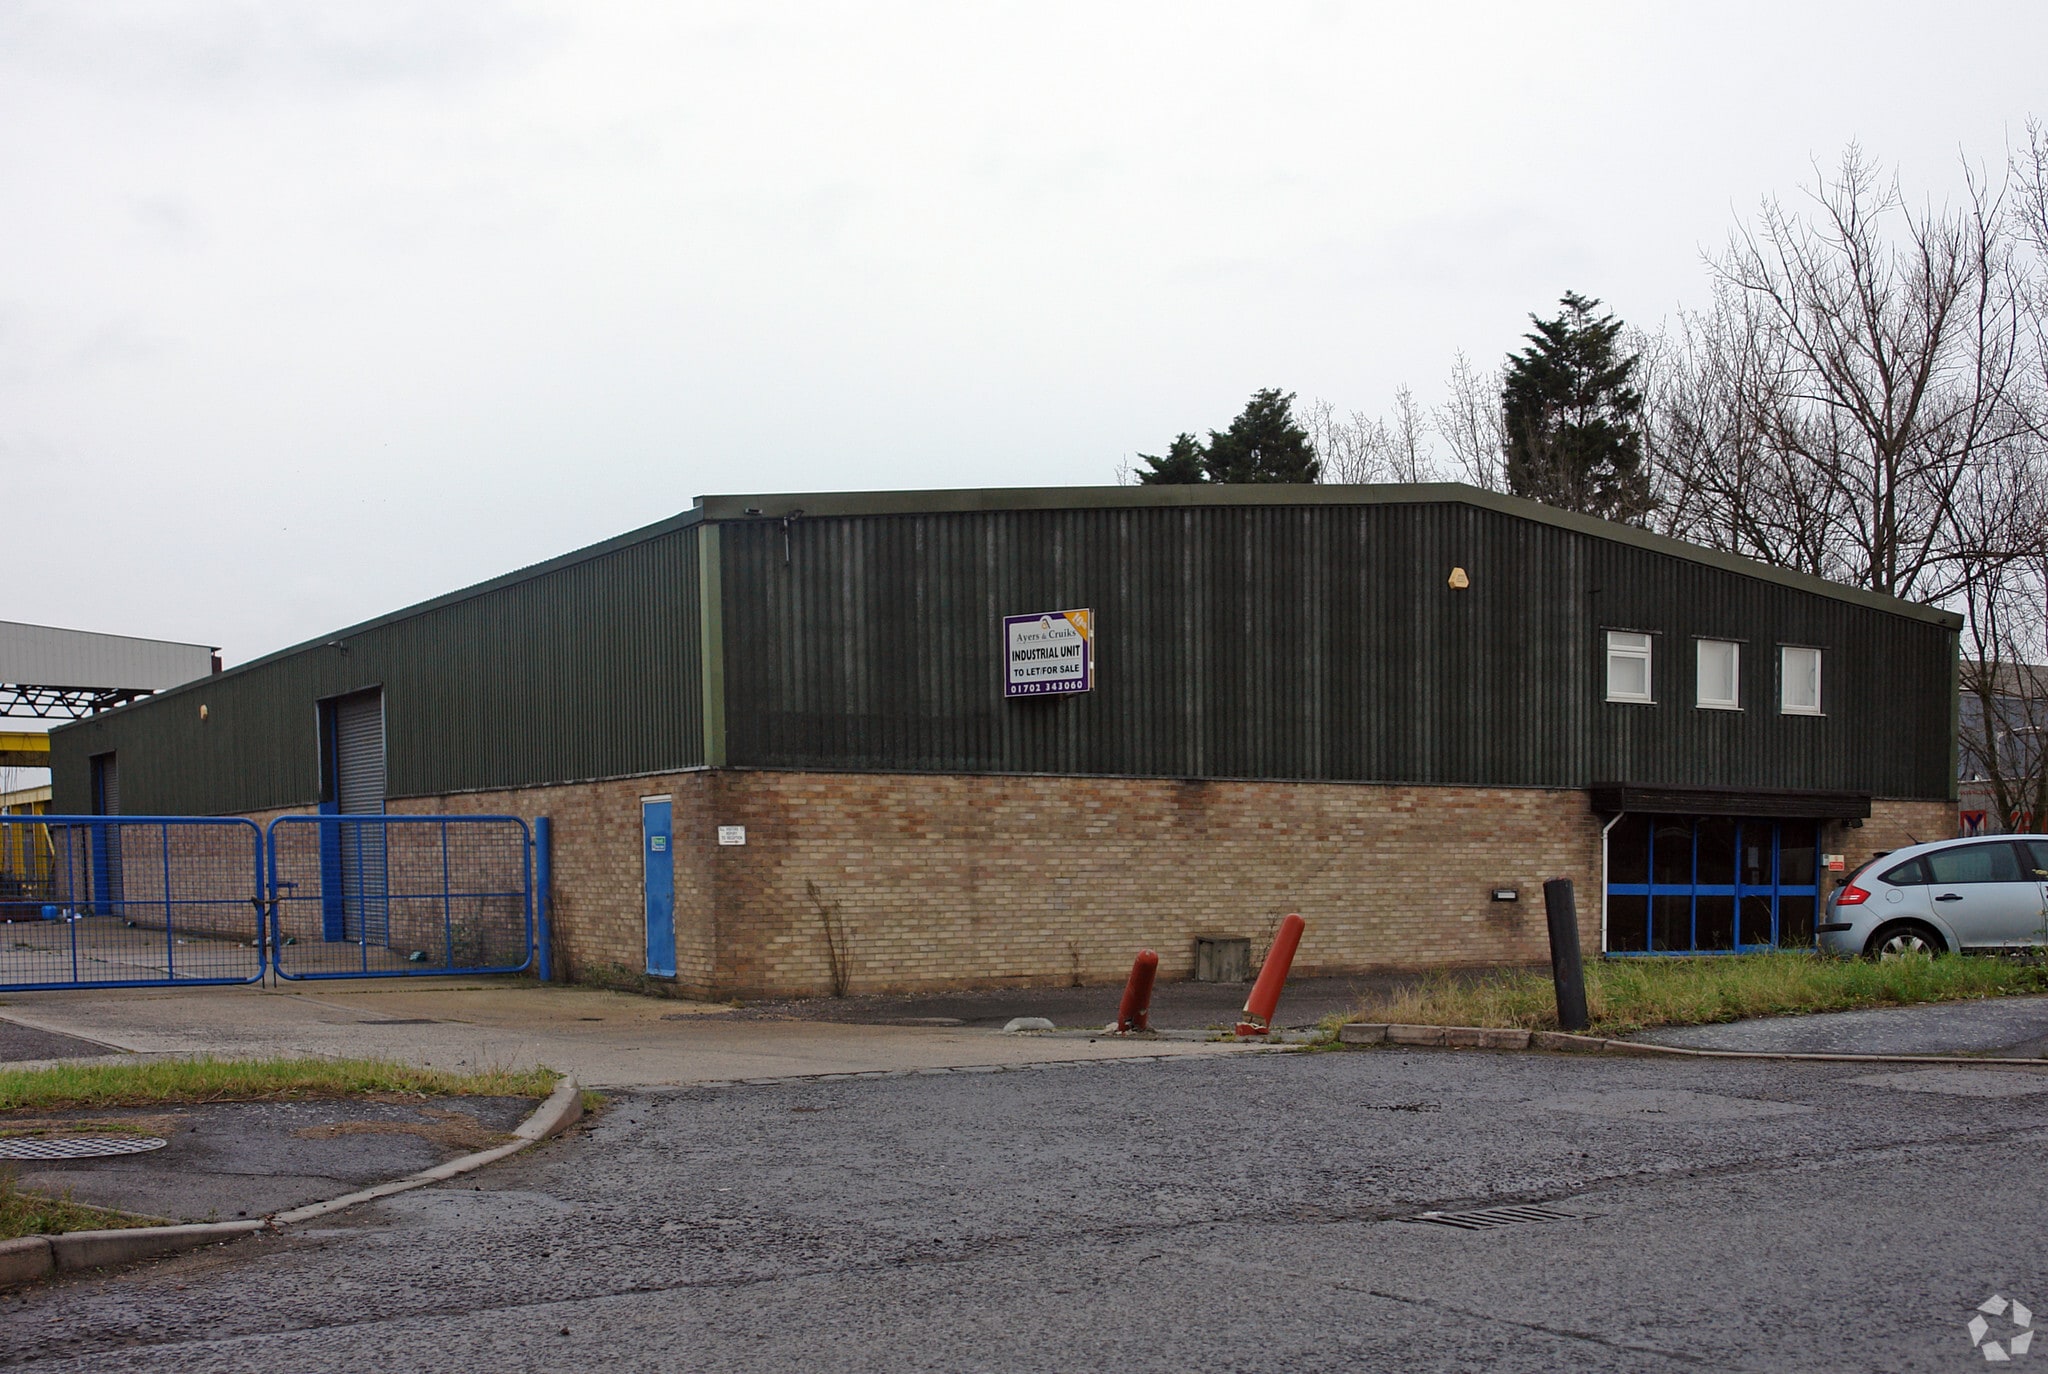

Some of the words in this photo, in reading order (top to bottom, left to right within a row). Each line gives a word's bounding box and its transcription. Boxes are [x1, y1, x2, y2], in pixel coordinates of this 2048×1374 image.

[1017, 633, 1040, 644] Ayers
[1012, 647, 1059, 662] INDUSTRIAL
[1060, 645, 1080, 657] UNIT
[1014, 669, 1024, 677] TO
[1026, 667, 1041, 676] LET
[1042, 665, 1058, 675] FOR
[1060, 664, 1080, 674] SALE
[1011, 684, 1041, 693] 01702
[1045, 681, 1083, 690] 343060
